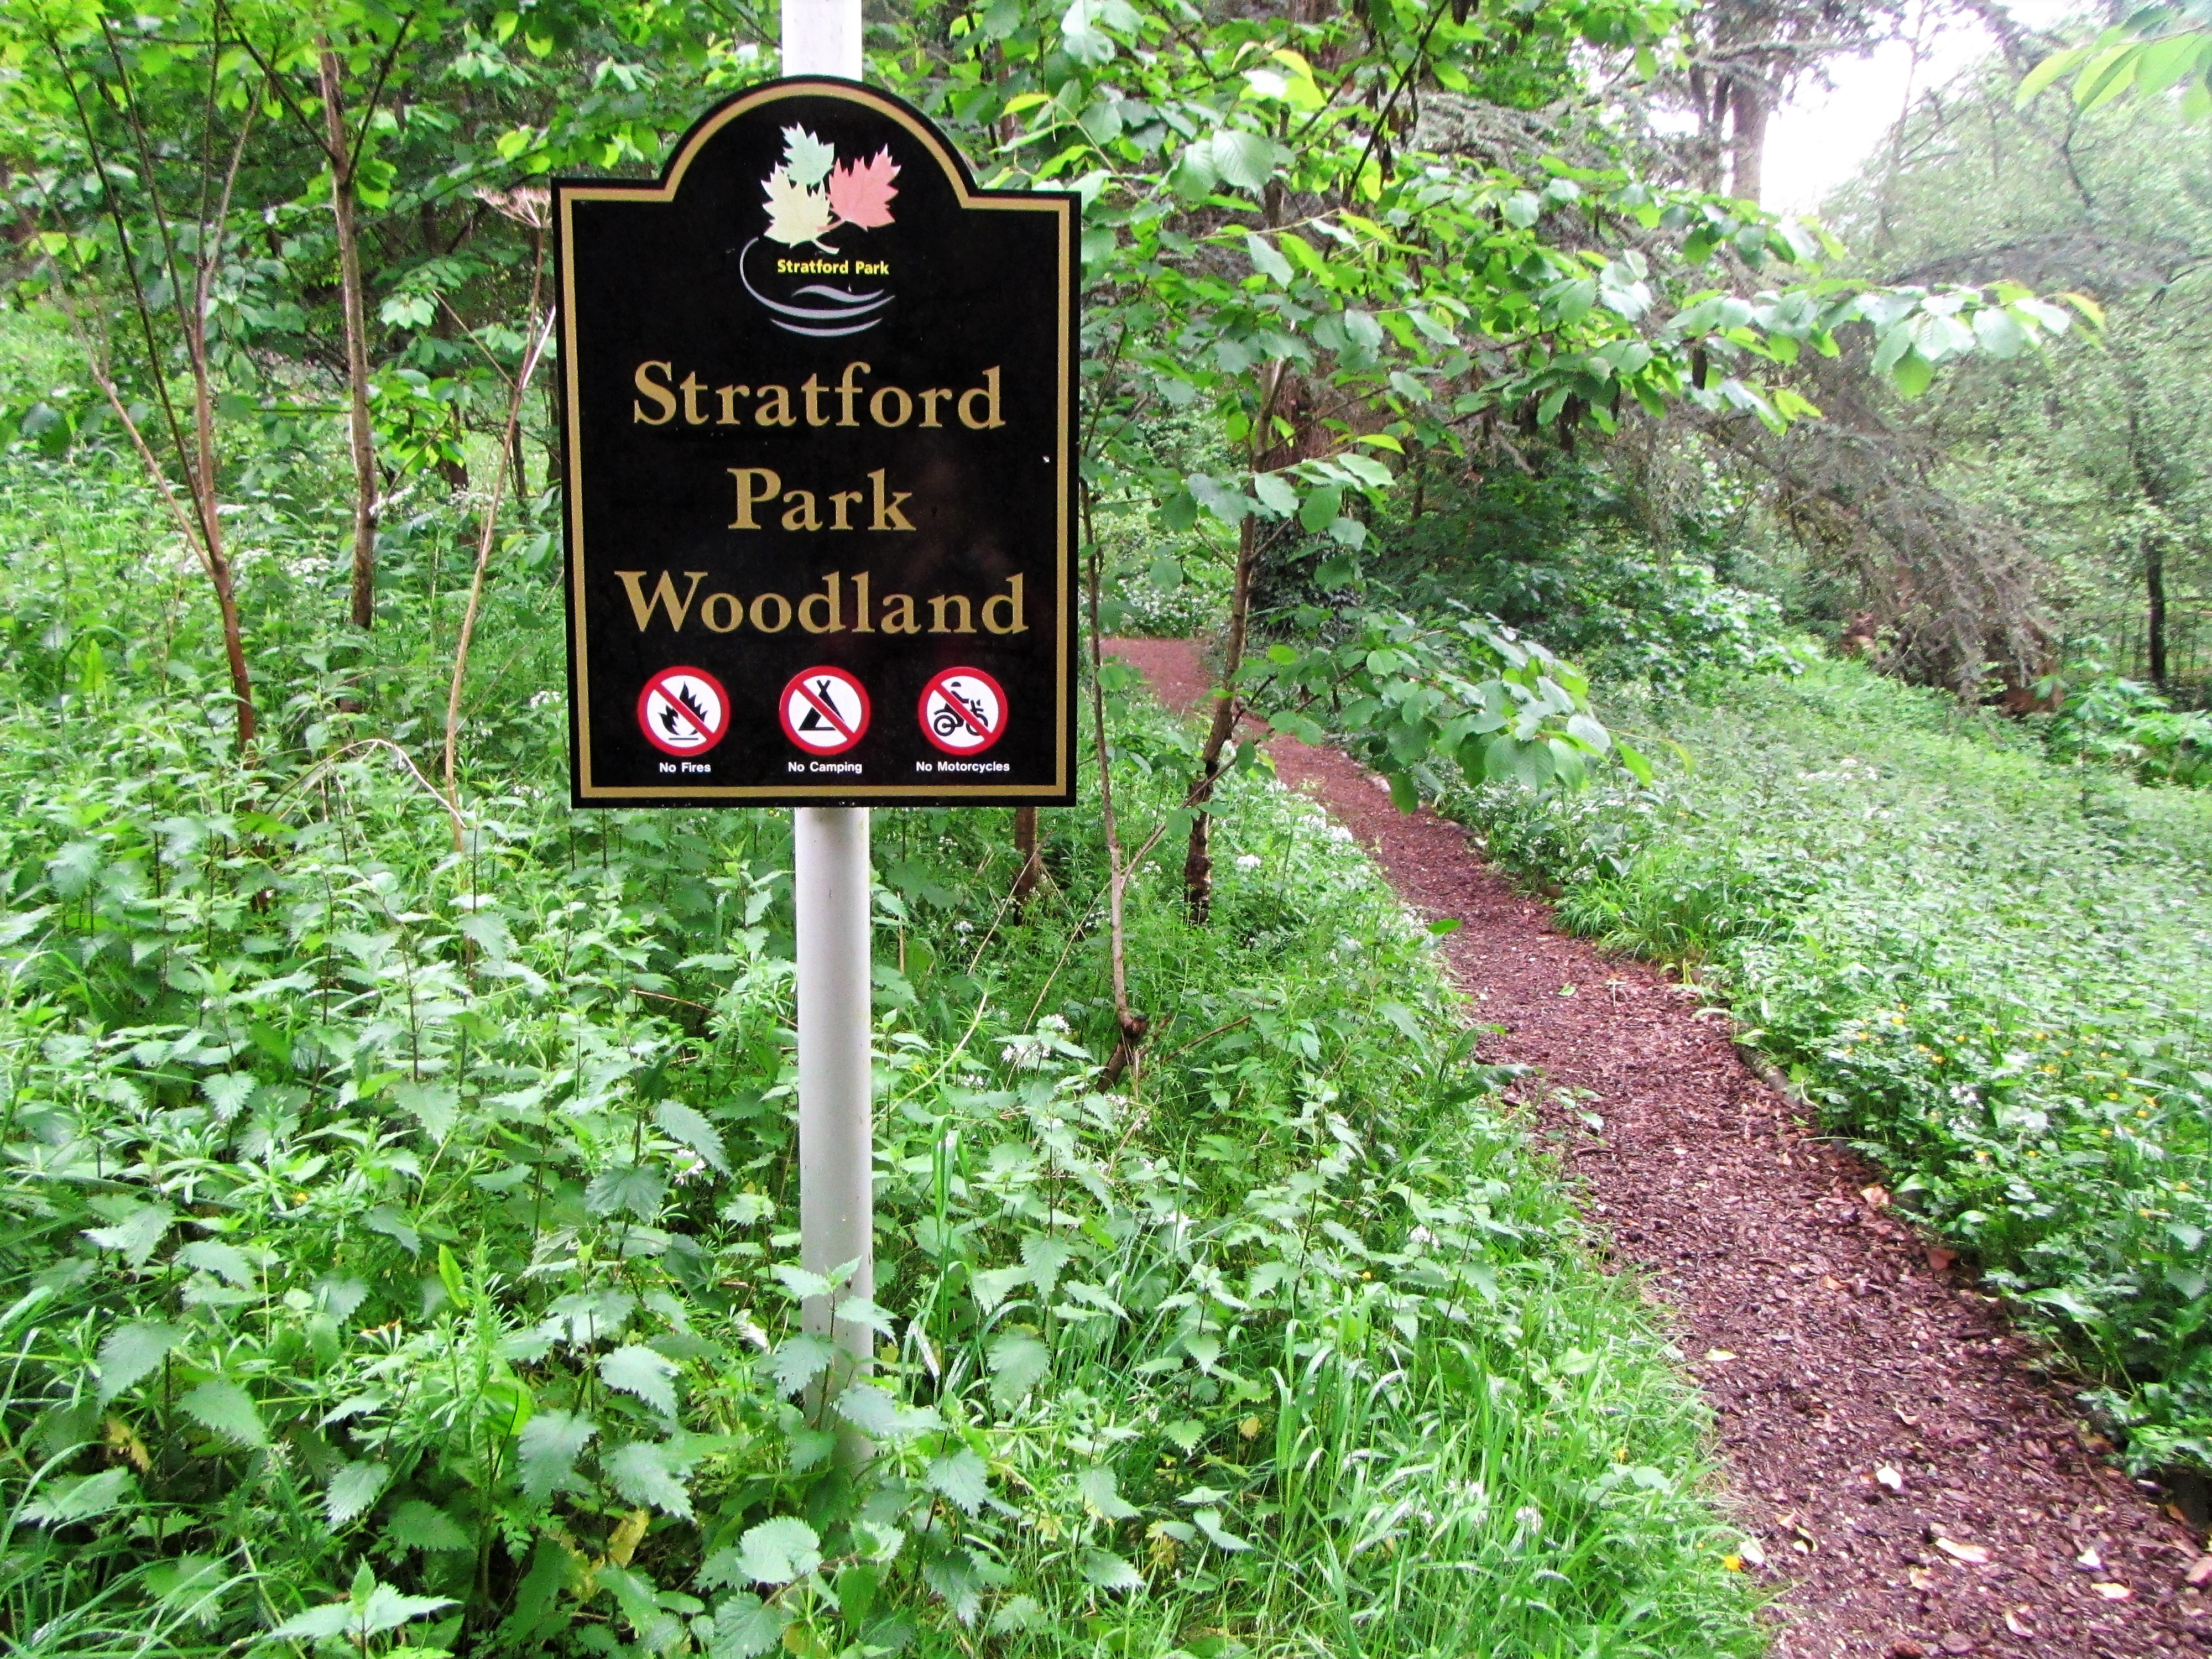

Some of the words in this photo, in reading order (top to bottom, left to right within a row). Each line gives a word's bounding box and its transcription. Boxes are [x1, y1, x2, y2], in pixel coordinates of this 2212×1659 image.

[777, 258, 849, 275] Stratford
[855, 259, 890, 275] Park
[634, 361, 1006, 430] Stratford
[726, 468, 917, 531] Park
[614, 570, 1029, 635] Woodland
[659, 761, 677, 773] No
[681, 761, 712, 773] Fires
[788, 761, 806, 773] No
[810, 760, 863, 774] Camping
[915, 760, 933, 773] No
[937, 760, 1010, 774] Motorcycles
